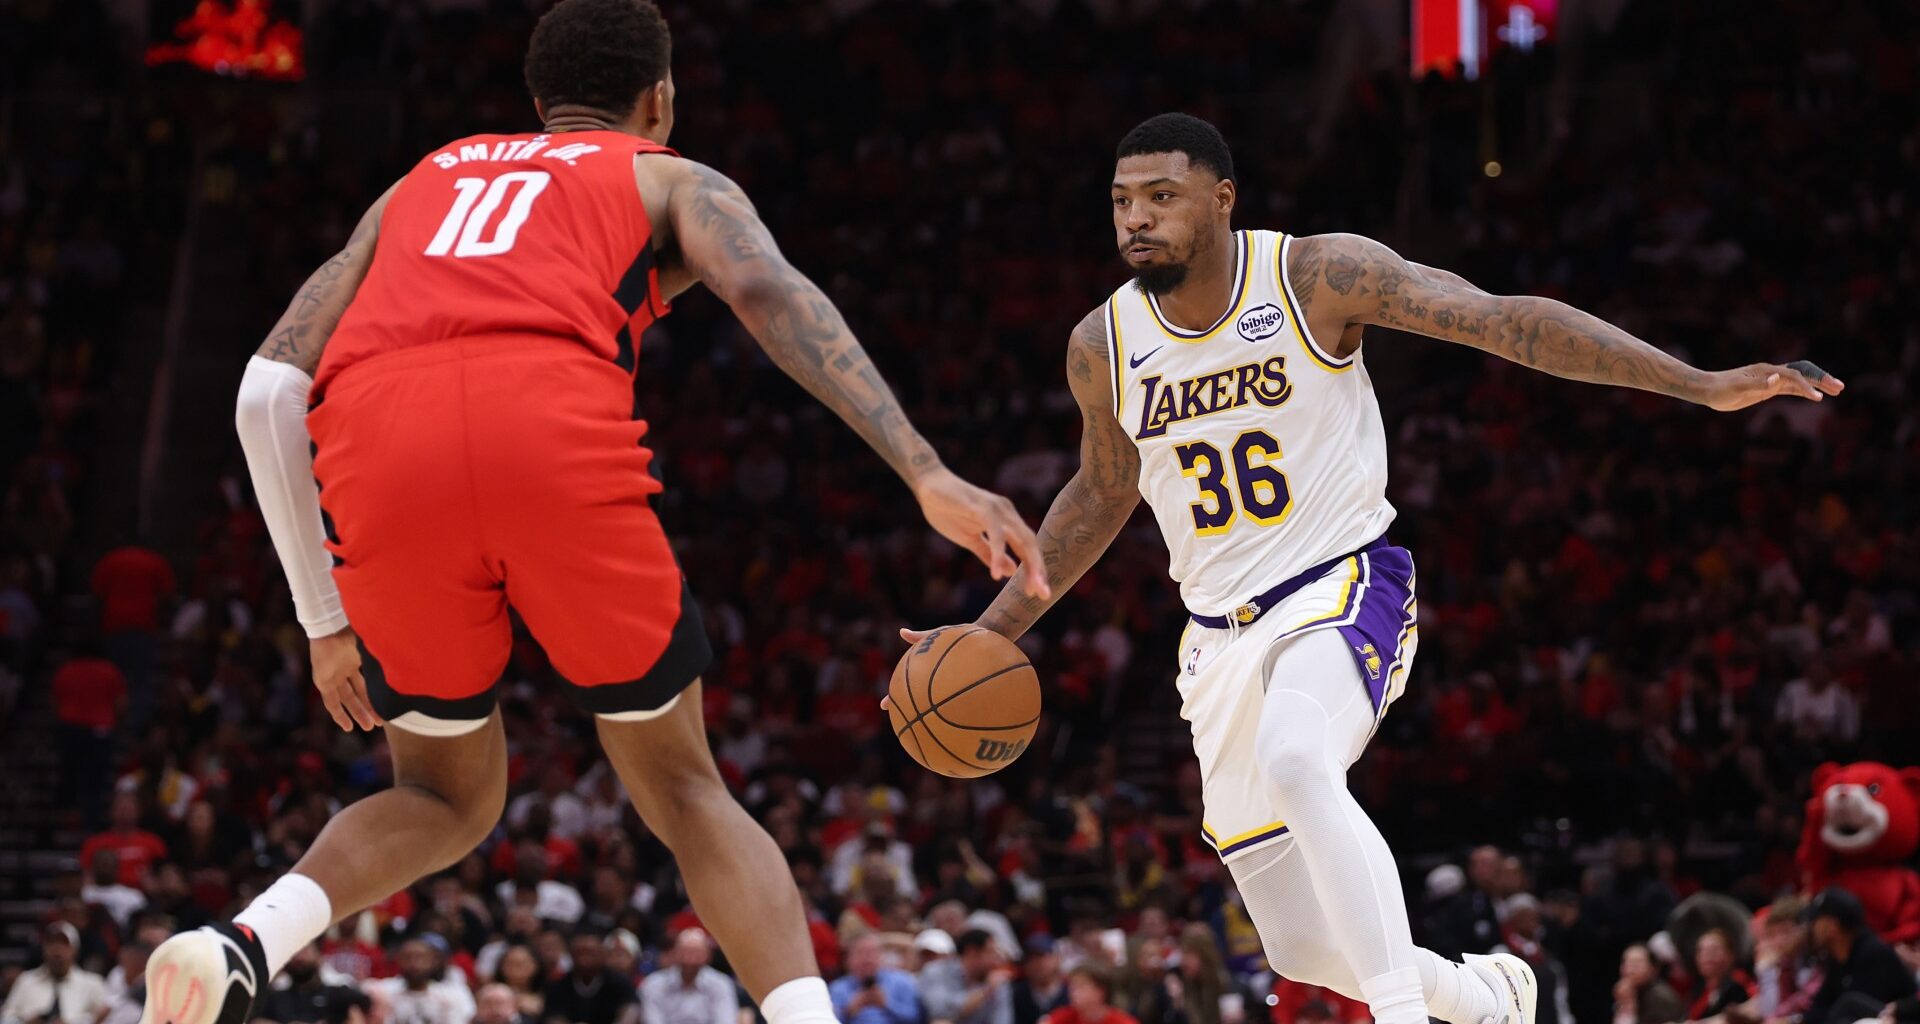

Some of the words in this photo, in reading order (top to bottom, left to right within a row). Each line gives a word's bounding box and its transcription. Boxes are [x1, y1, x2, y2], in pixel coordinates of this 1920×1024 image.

[433, 141, 550, 169] SMITH
[424, 171, 551, 258] 10
[1240, 312, 1281, 331] bibigo
[1135, 354, 1294, 443] LAKERS
[1172, 427, 1295, 538] 36
[976, 738, 1026, 762] Wil
